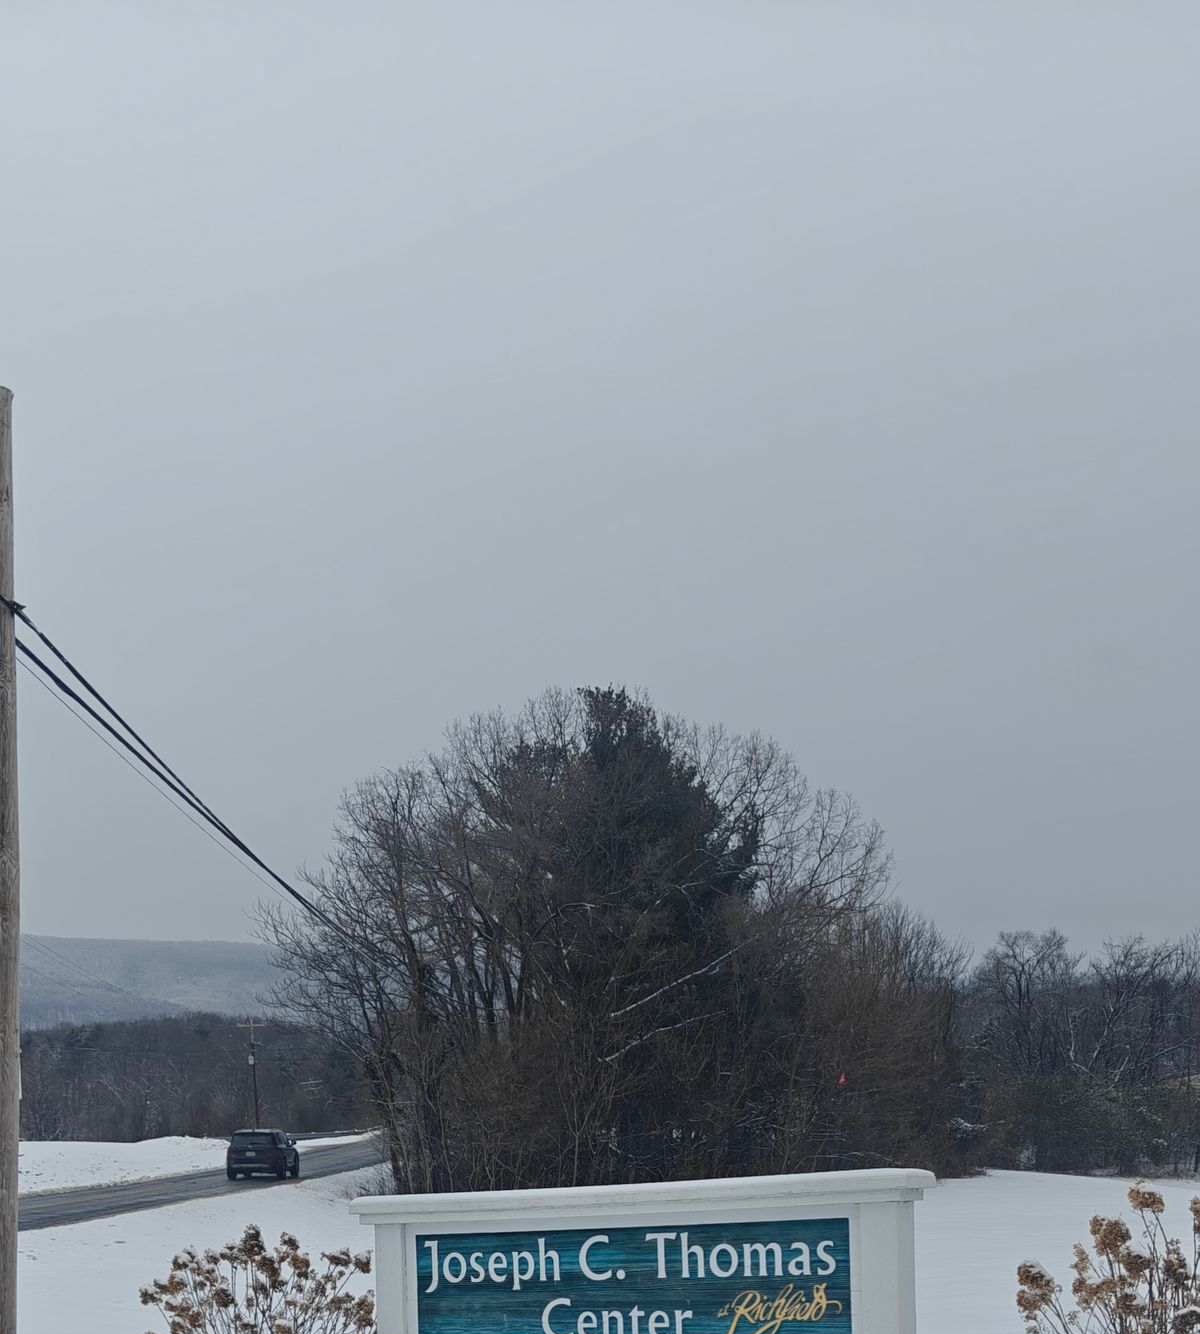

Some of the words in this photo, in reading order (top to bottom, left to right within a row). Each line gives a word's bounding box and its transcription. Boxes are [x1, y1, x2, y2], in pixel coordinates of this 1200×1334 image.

[424, 1237, 561, 1293] Joseph
[579, 1235, 626, 1281] C.
[645, 1232, 836, 1279] Thomas
